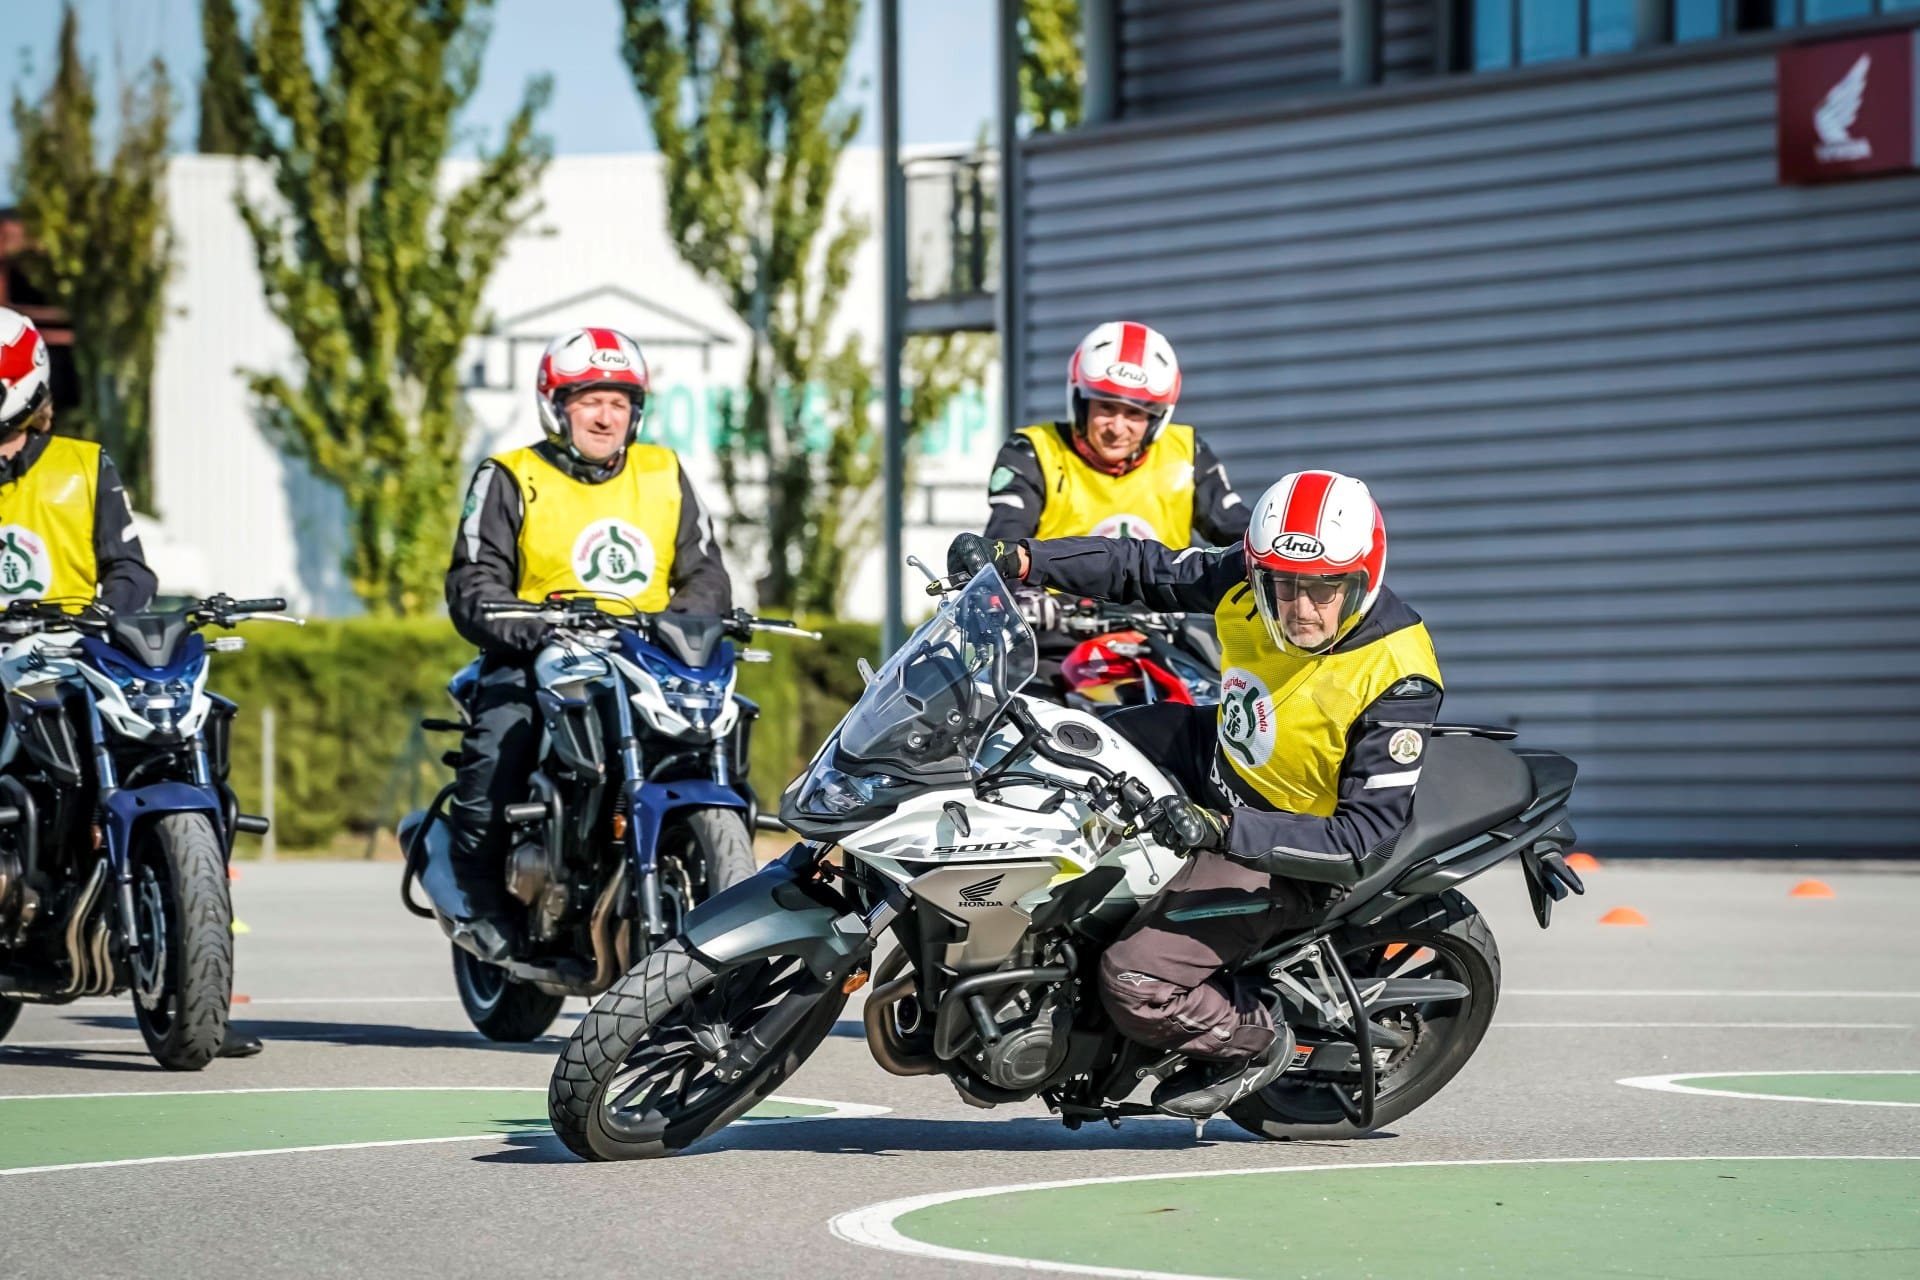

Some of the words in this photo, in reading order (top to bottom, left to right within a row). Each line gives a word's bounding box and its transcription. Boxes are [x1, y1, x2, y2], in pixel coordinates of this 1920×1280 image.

[1275, 536, 1319, 554] Arai
[1255, 700, 1268, 733] Honda
[929, 840, 1037, 856] 500X
